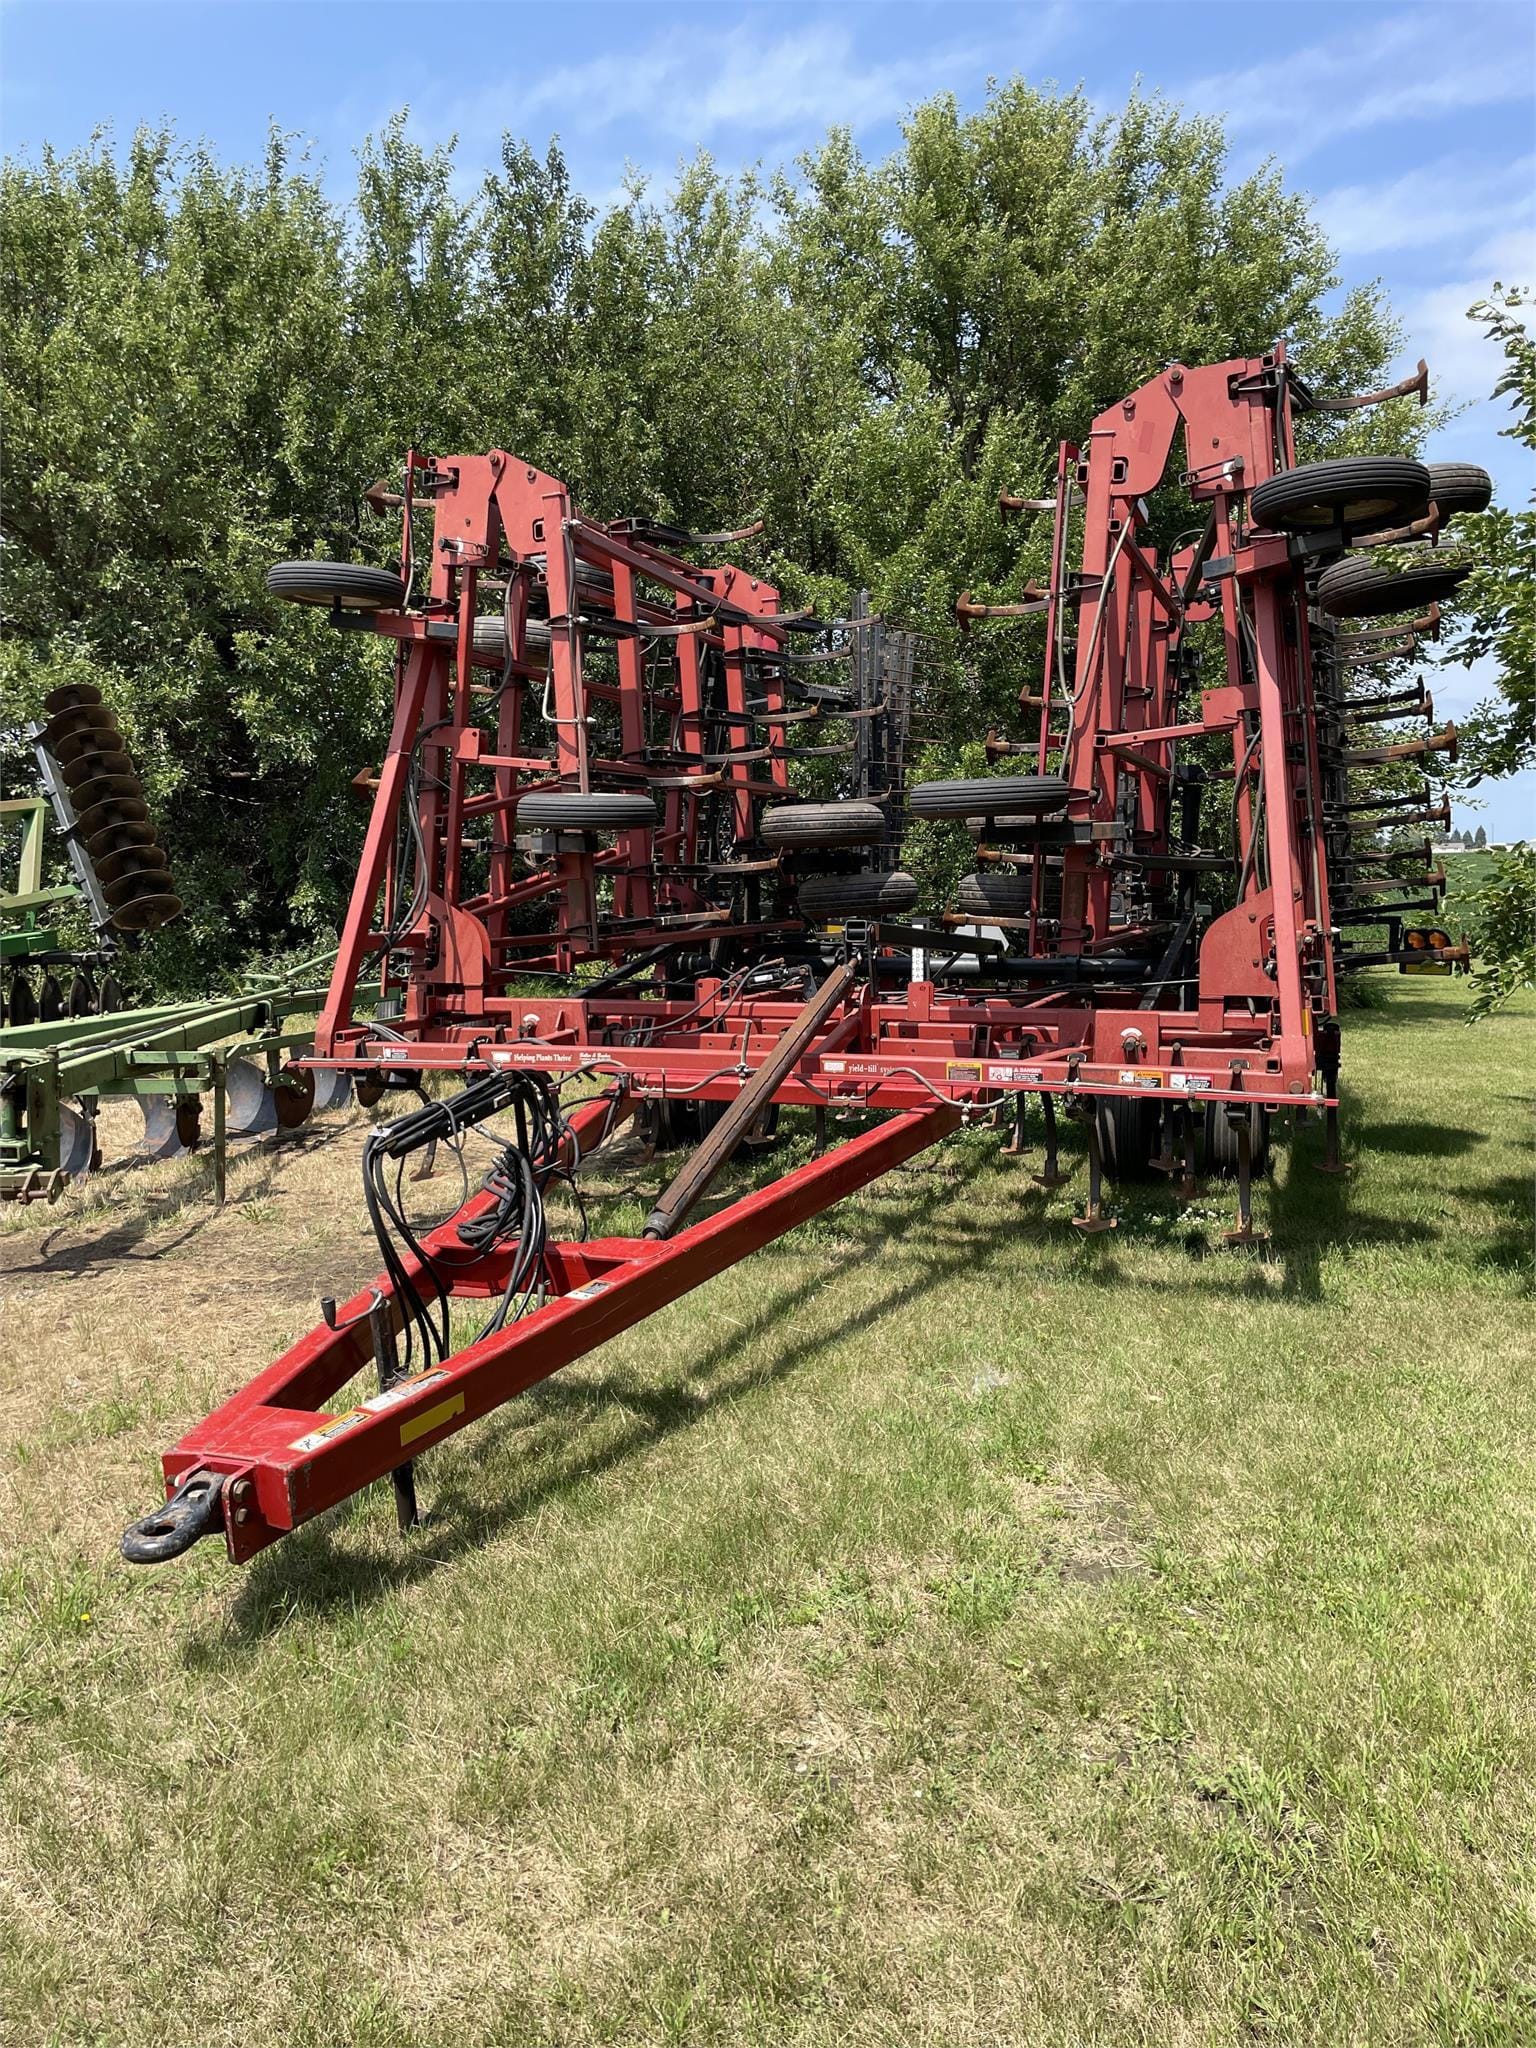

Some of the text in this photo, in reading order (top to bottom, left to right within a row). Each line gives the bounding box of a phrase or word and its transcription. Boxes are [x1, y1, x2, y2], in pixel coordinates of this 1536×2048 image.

[513, 1053, 536, 1063] Helping
[536, 1053, 553, 1062] Plants
[848, 1064, 877, 1074] yield-till
